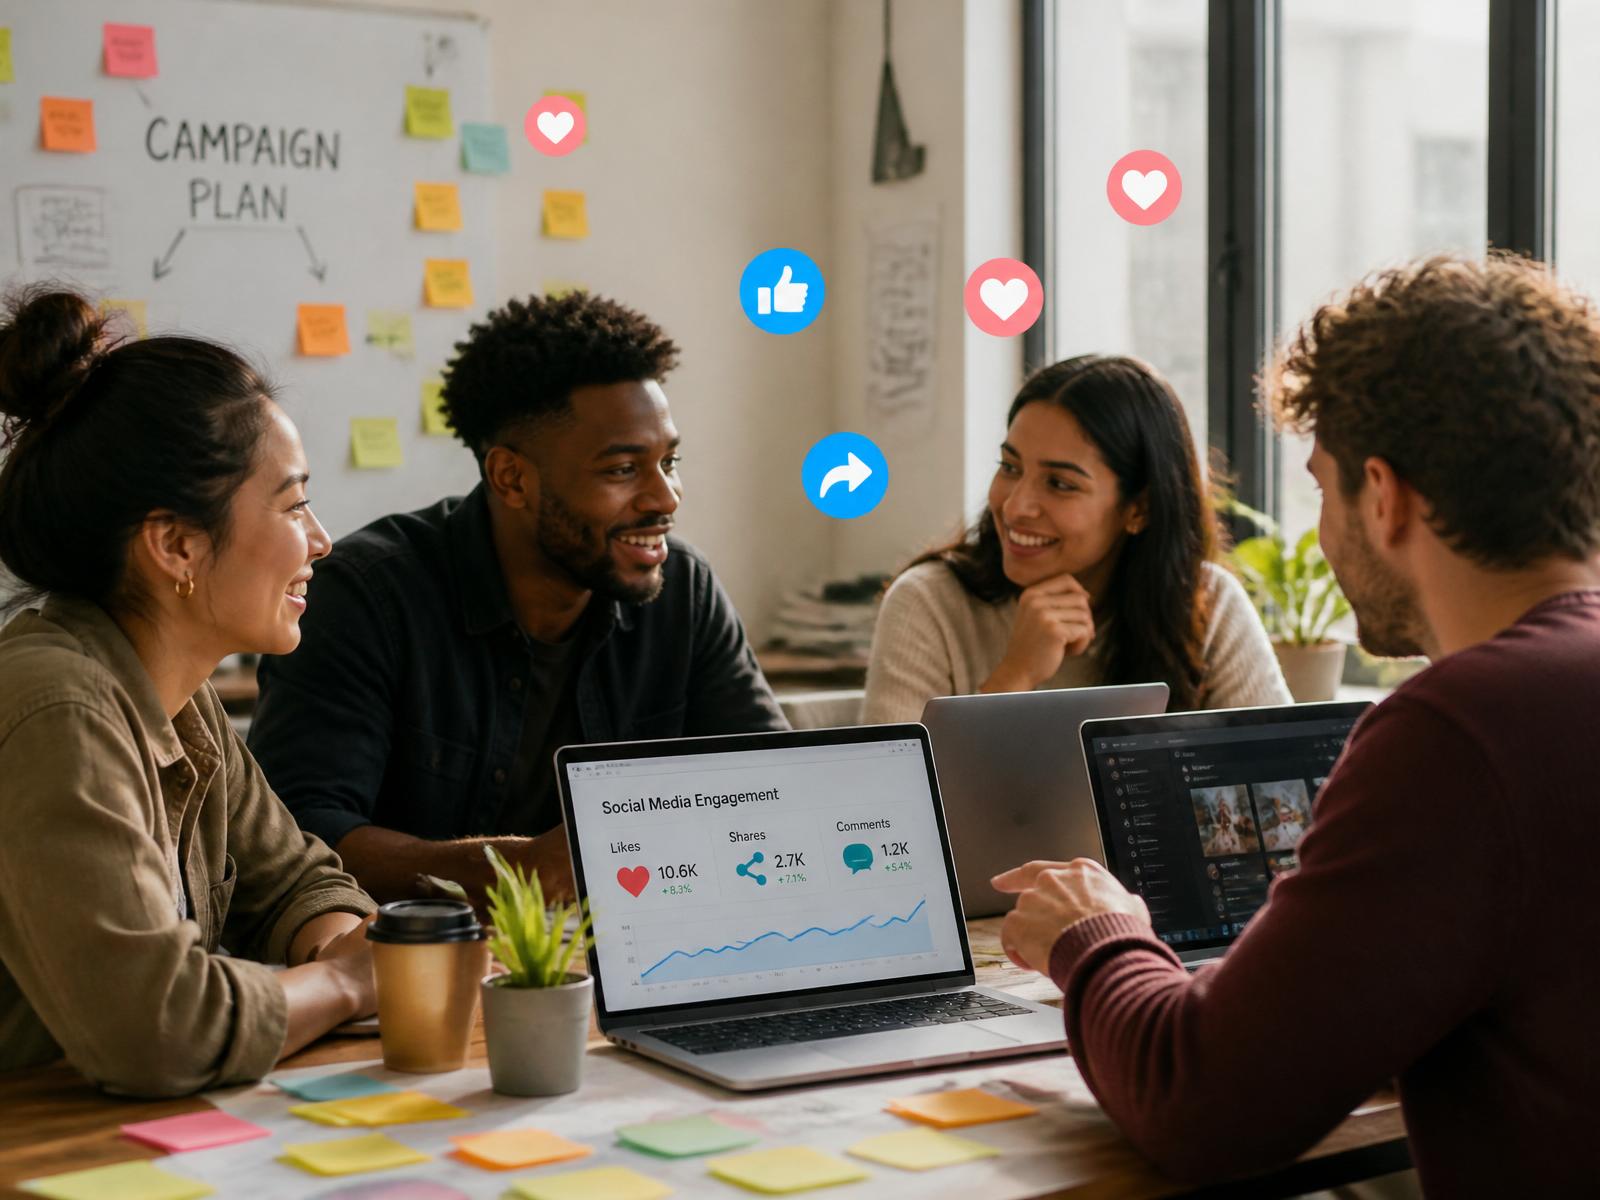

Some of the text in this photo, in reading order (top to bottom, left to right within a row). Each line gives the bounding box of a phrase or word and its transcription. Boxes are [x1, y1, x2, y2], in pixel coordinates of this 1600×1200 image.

[145, 116, 341, 170] CAMPAIGN
[189, 178, 287, 219] PLAN
[602, 788, 780, 815] Social Media Engagement
[836, 819, 891, 832] Comments
[729, 831, 766, 843] Shares
[610, 841, 641, 854] Likes
[881, 841, 910, 857] 1.2K
[774, 852, 806, 868] 2.7K
[657, 863, 699, 880] 10.6K
